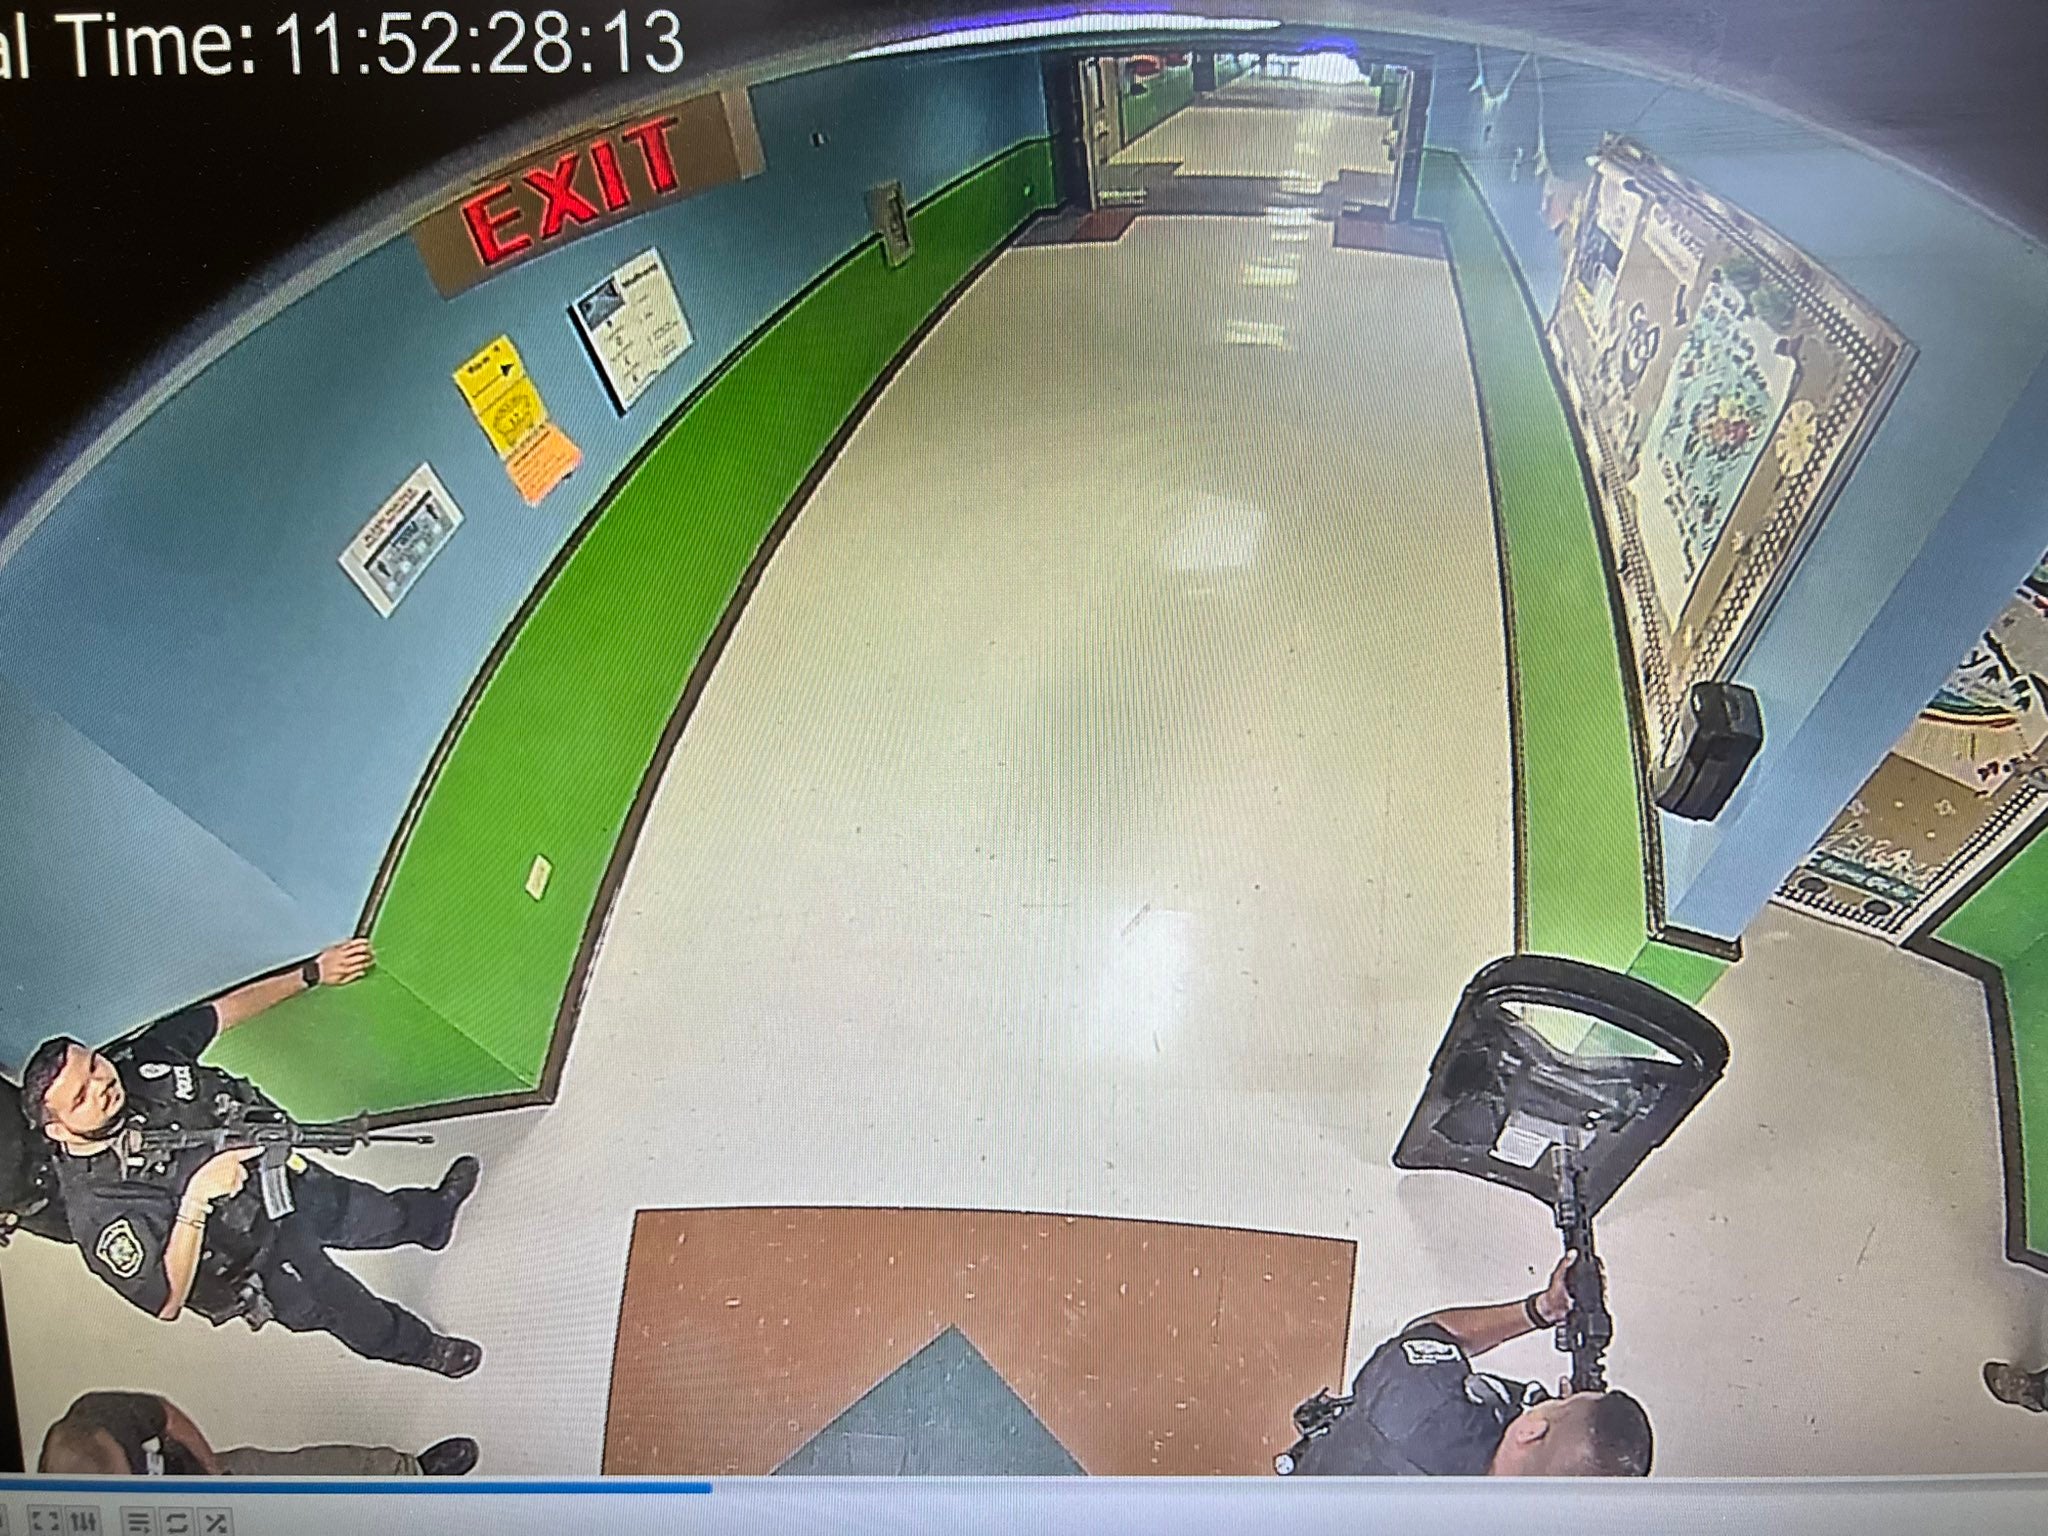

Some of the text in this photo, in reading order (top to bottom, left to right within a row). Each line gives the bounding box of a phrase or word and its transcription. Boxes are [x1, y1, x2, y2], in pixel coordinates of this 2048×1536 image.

[54, 11, 253, 77] Time:
[276, 9, 684, 75] 11:52:28:13
[461, 117, 679, 267] EXIT
